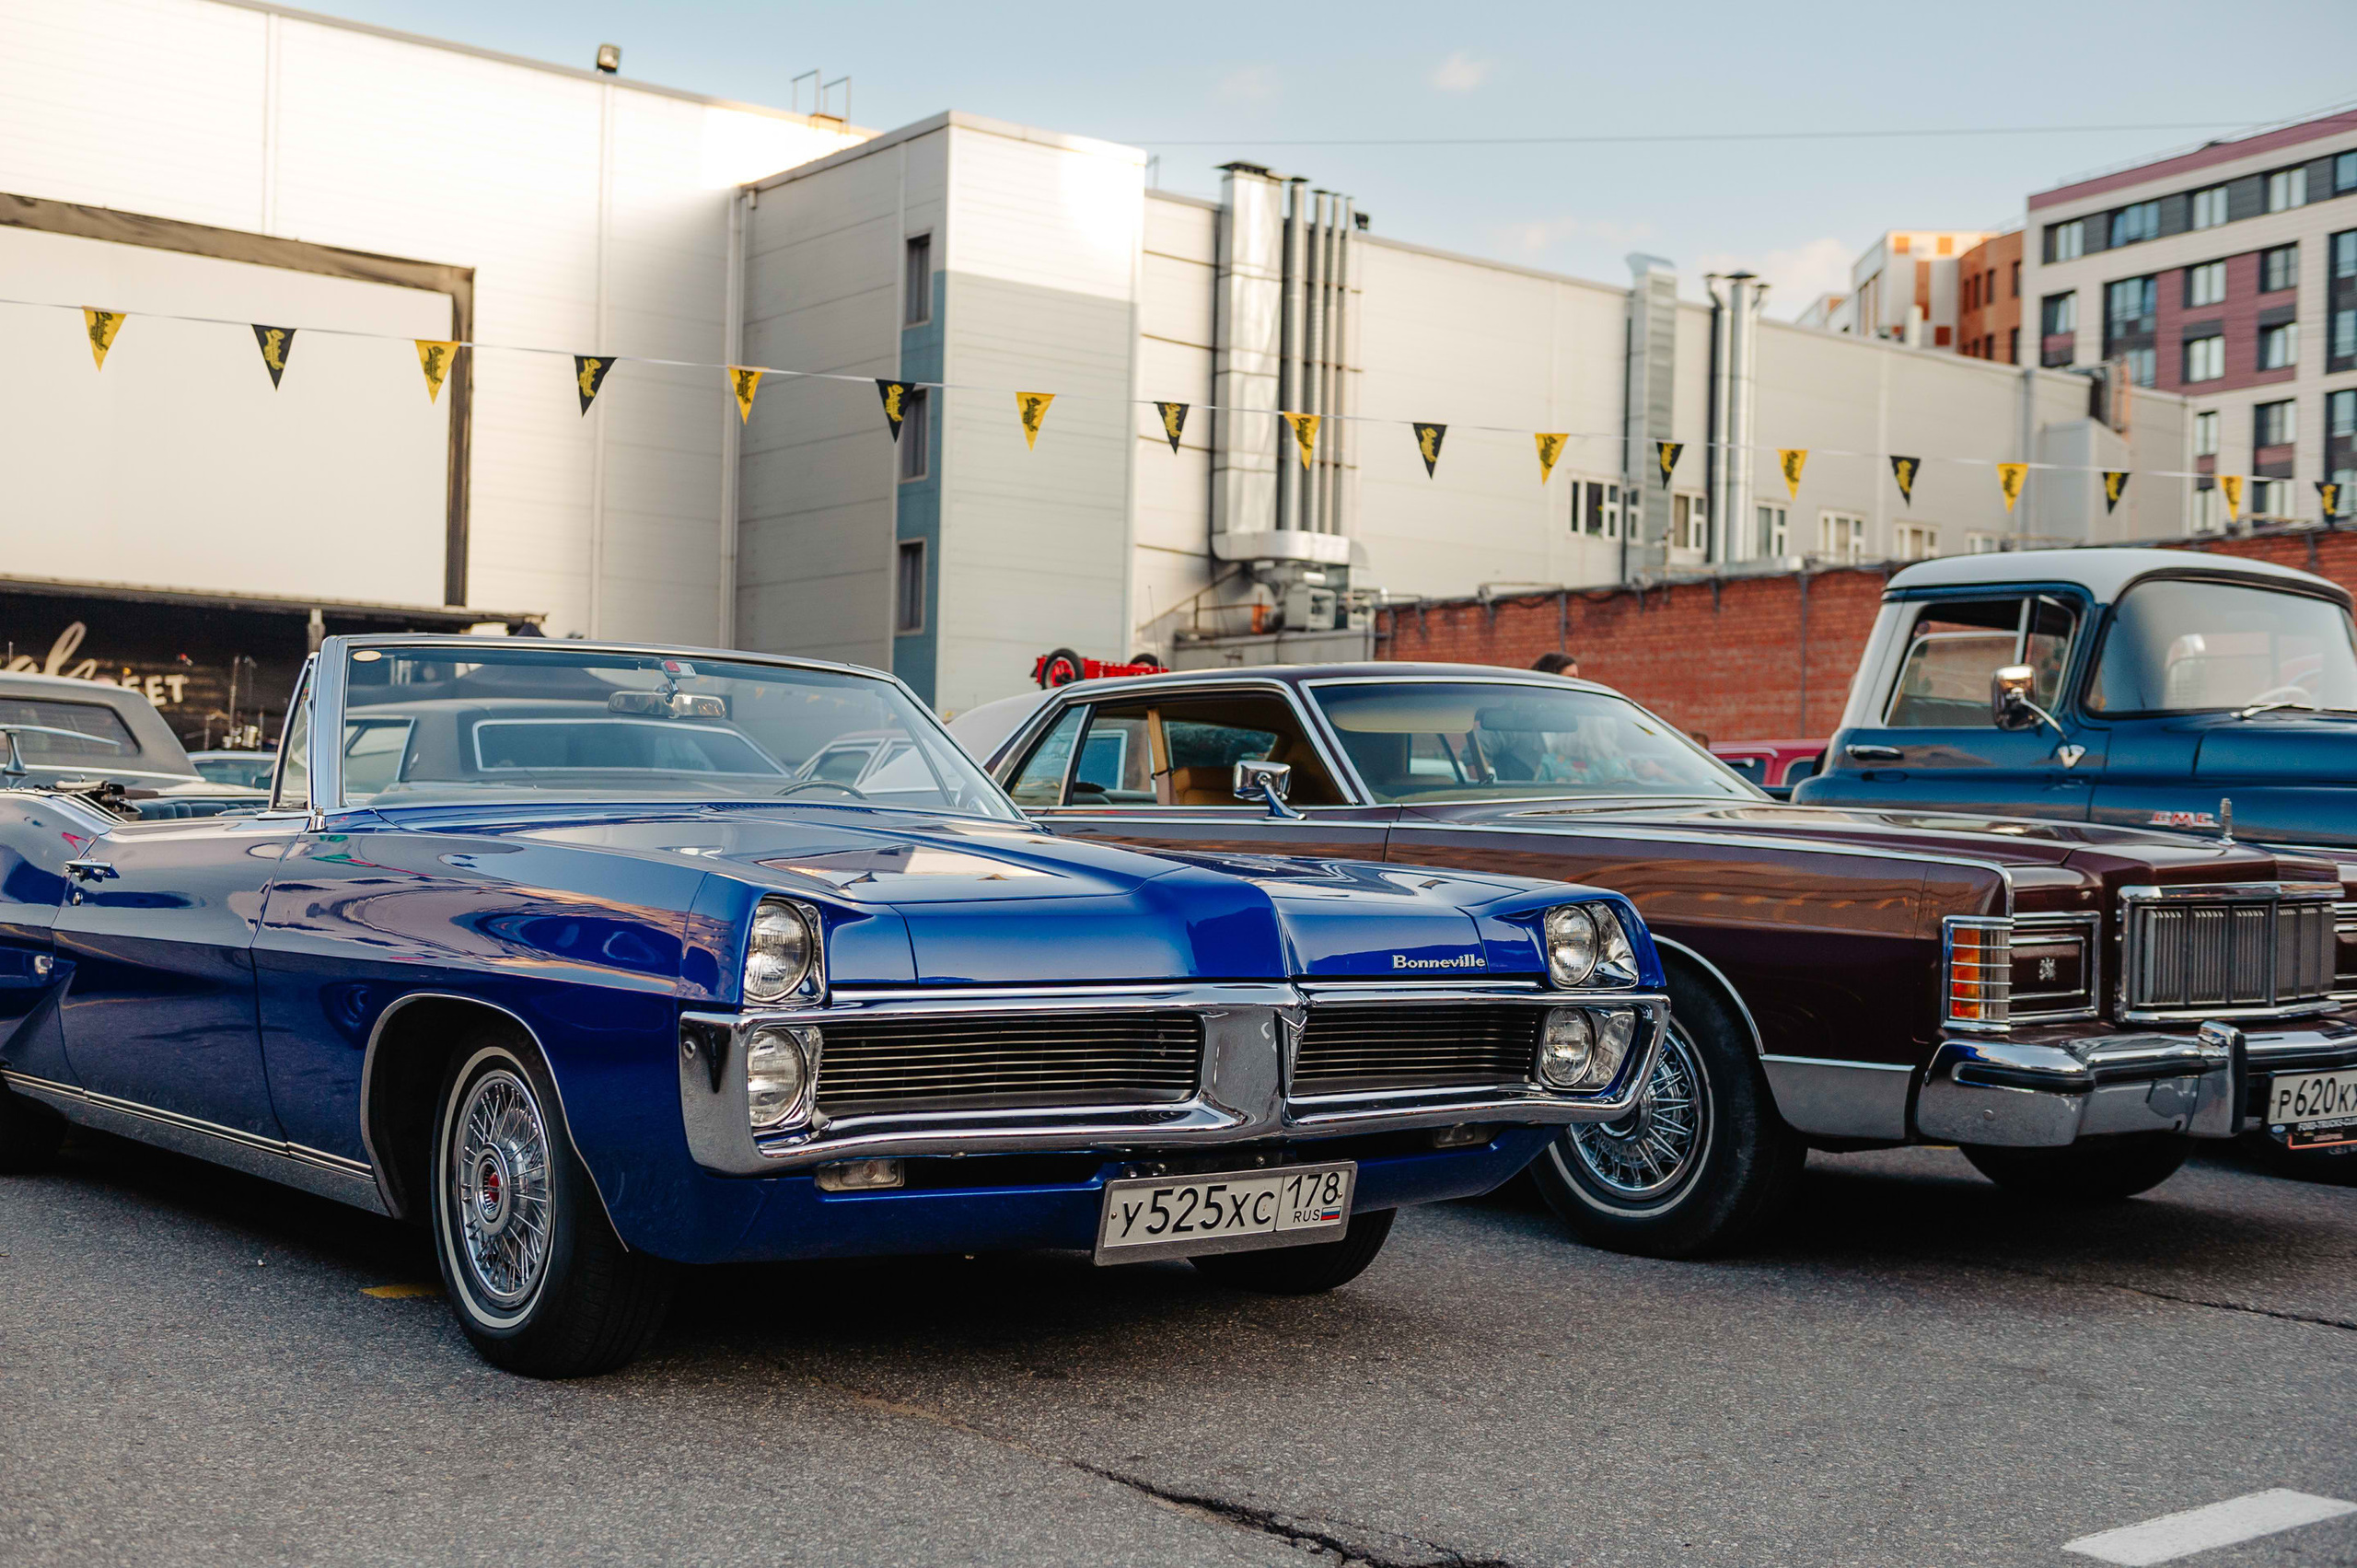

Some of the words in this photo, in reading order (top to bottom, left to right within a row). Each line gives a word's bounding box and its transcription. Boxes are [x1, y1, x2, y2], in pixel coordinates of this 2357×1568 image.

[121, 674, 190, 706] EET
[1392, 954, 1487, 970] Bonneville
[1287, 1172, 1341, 1209] 178
[1293, 1209, 1320, 1223] RUS
